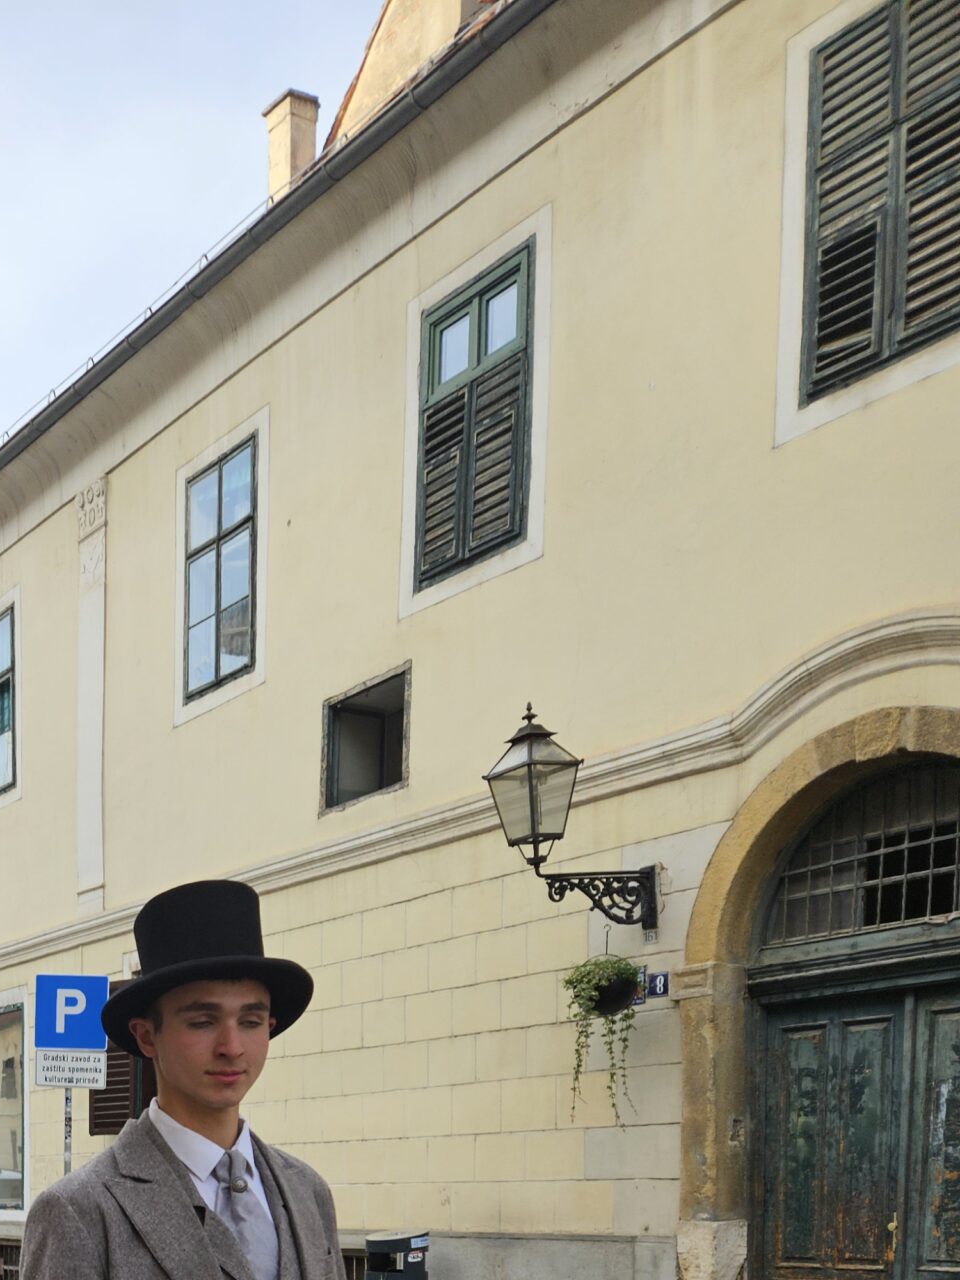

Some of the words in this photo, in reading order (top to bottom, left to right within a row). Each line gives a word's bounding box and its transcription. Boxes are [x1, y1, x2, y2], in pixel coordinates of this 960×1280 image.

[656, 975, 665, 994] 8
[55, 988, 87, 1034] P
[43, 1053, 69, 1063] Gradski
[71, 1055, 91, 1063] zavod
[68, 1066, 102, 1075] spomenika
[75, 1076, 99, 1085] prirode
